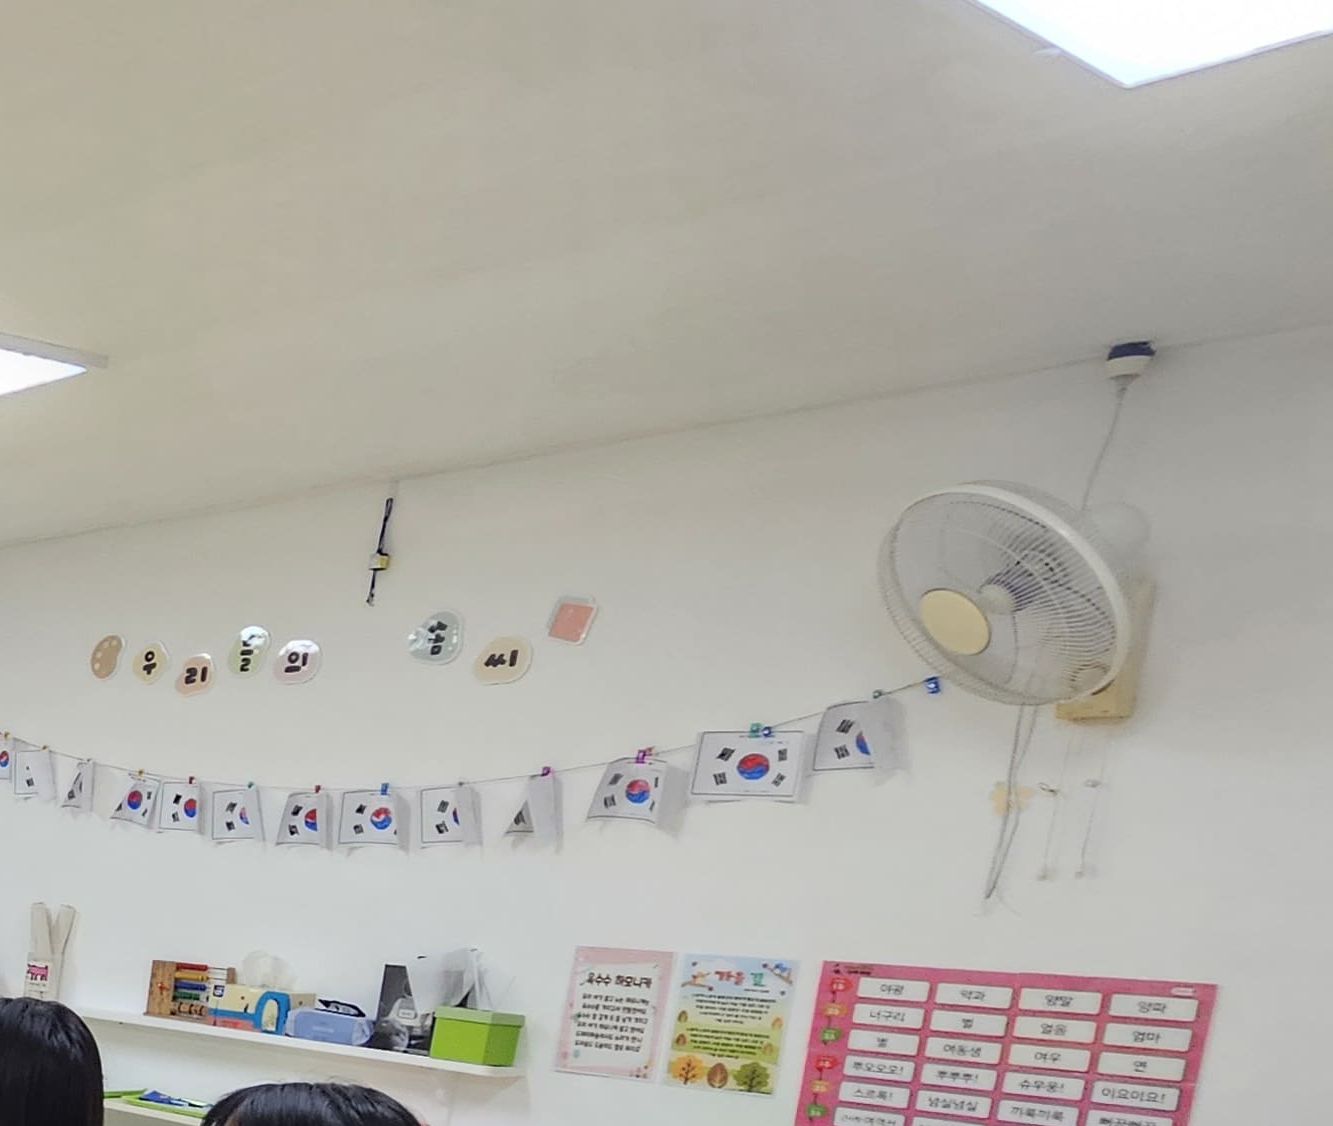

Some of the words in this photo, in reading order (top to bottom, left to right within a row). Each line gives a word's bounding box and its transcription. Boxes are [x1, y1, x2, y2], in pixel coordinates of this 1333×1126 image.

[869, 1010, 907, 1023] 너구리
[943, 1043, 982, 1058] 여동생
[1034, 1051, 1061, 1064] 여우
